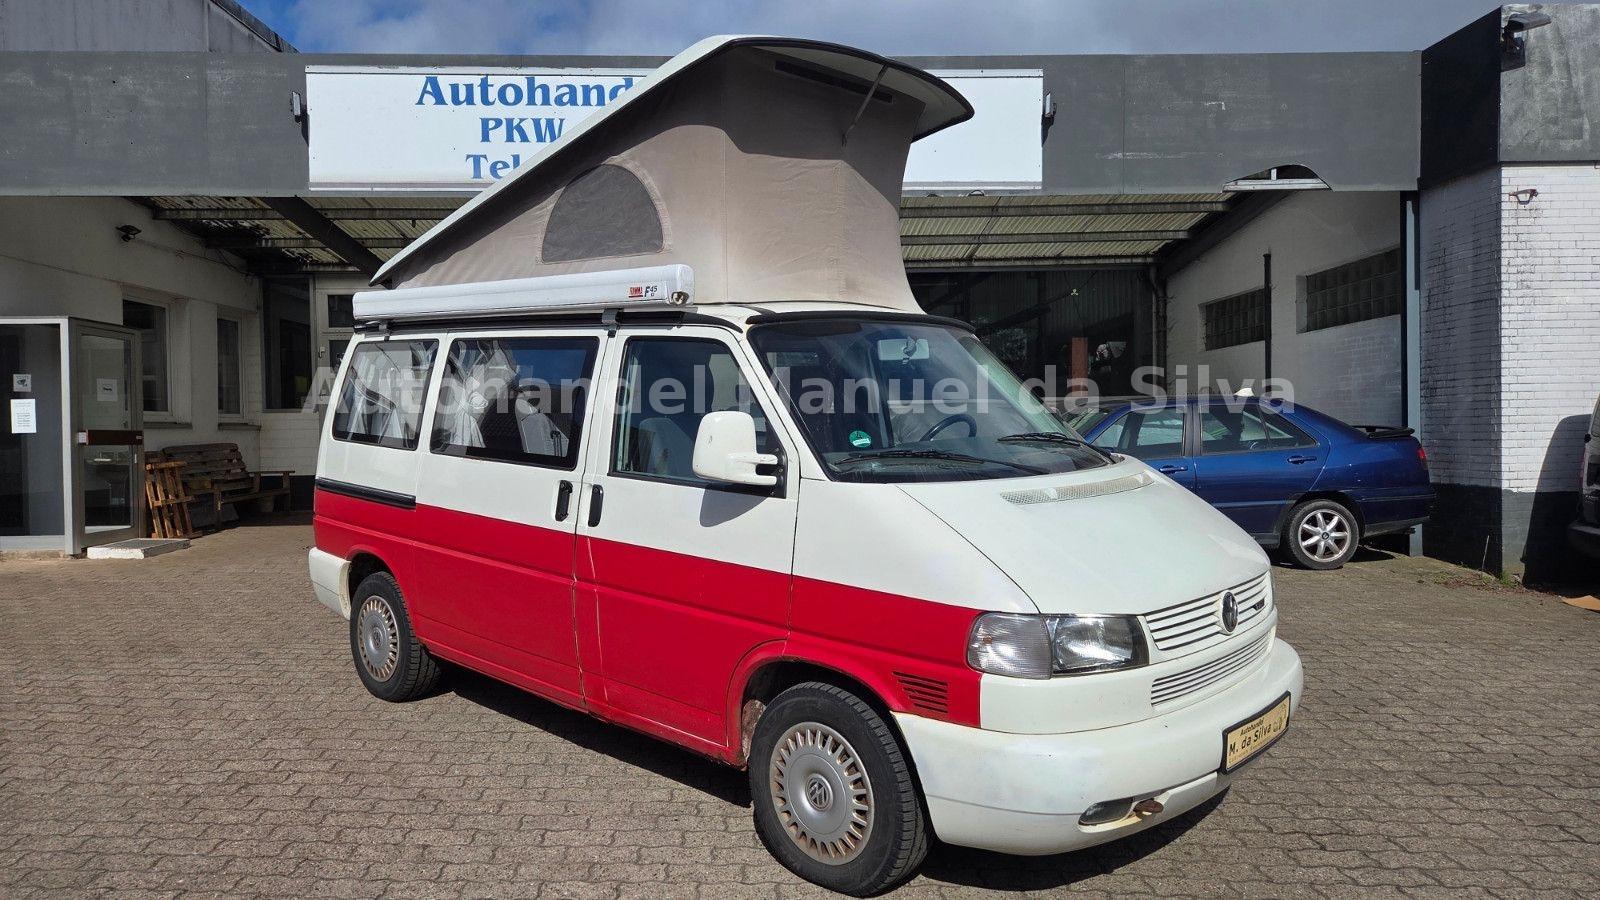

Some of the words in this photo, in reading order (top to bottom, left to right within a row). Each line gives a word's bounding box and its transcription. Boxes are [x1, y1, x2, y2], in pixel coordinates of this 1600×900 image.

[480, 117, 565, 143] PKW
[1241, 735, 1252, 750] da
[1253, 723, 1272, 742] Silva
